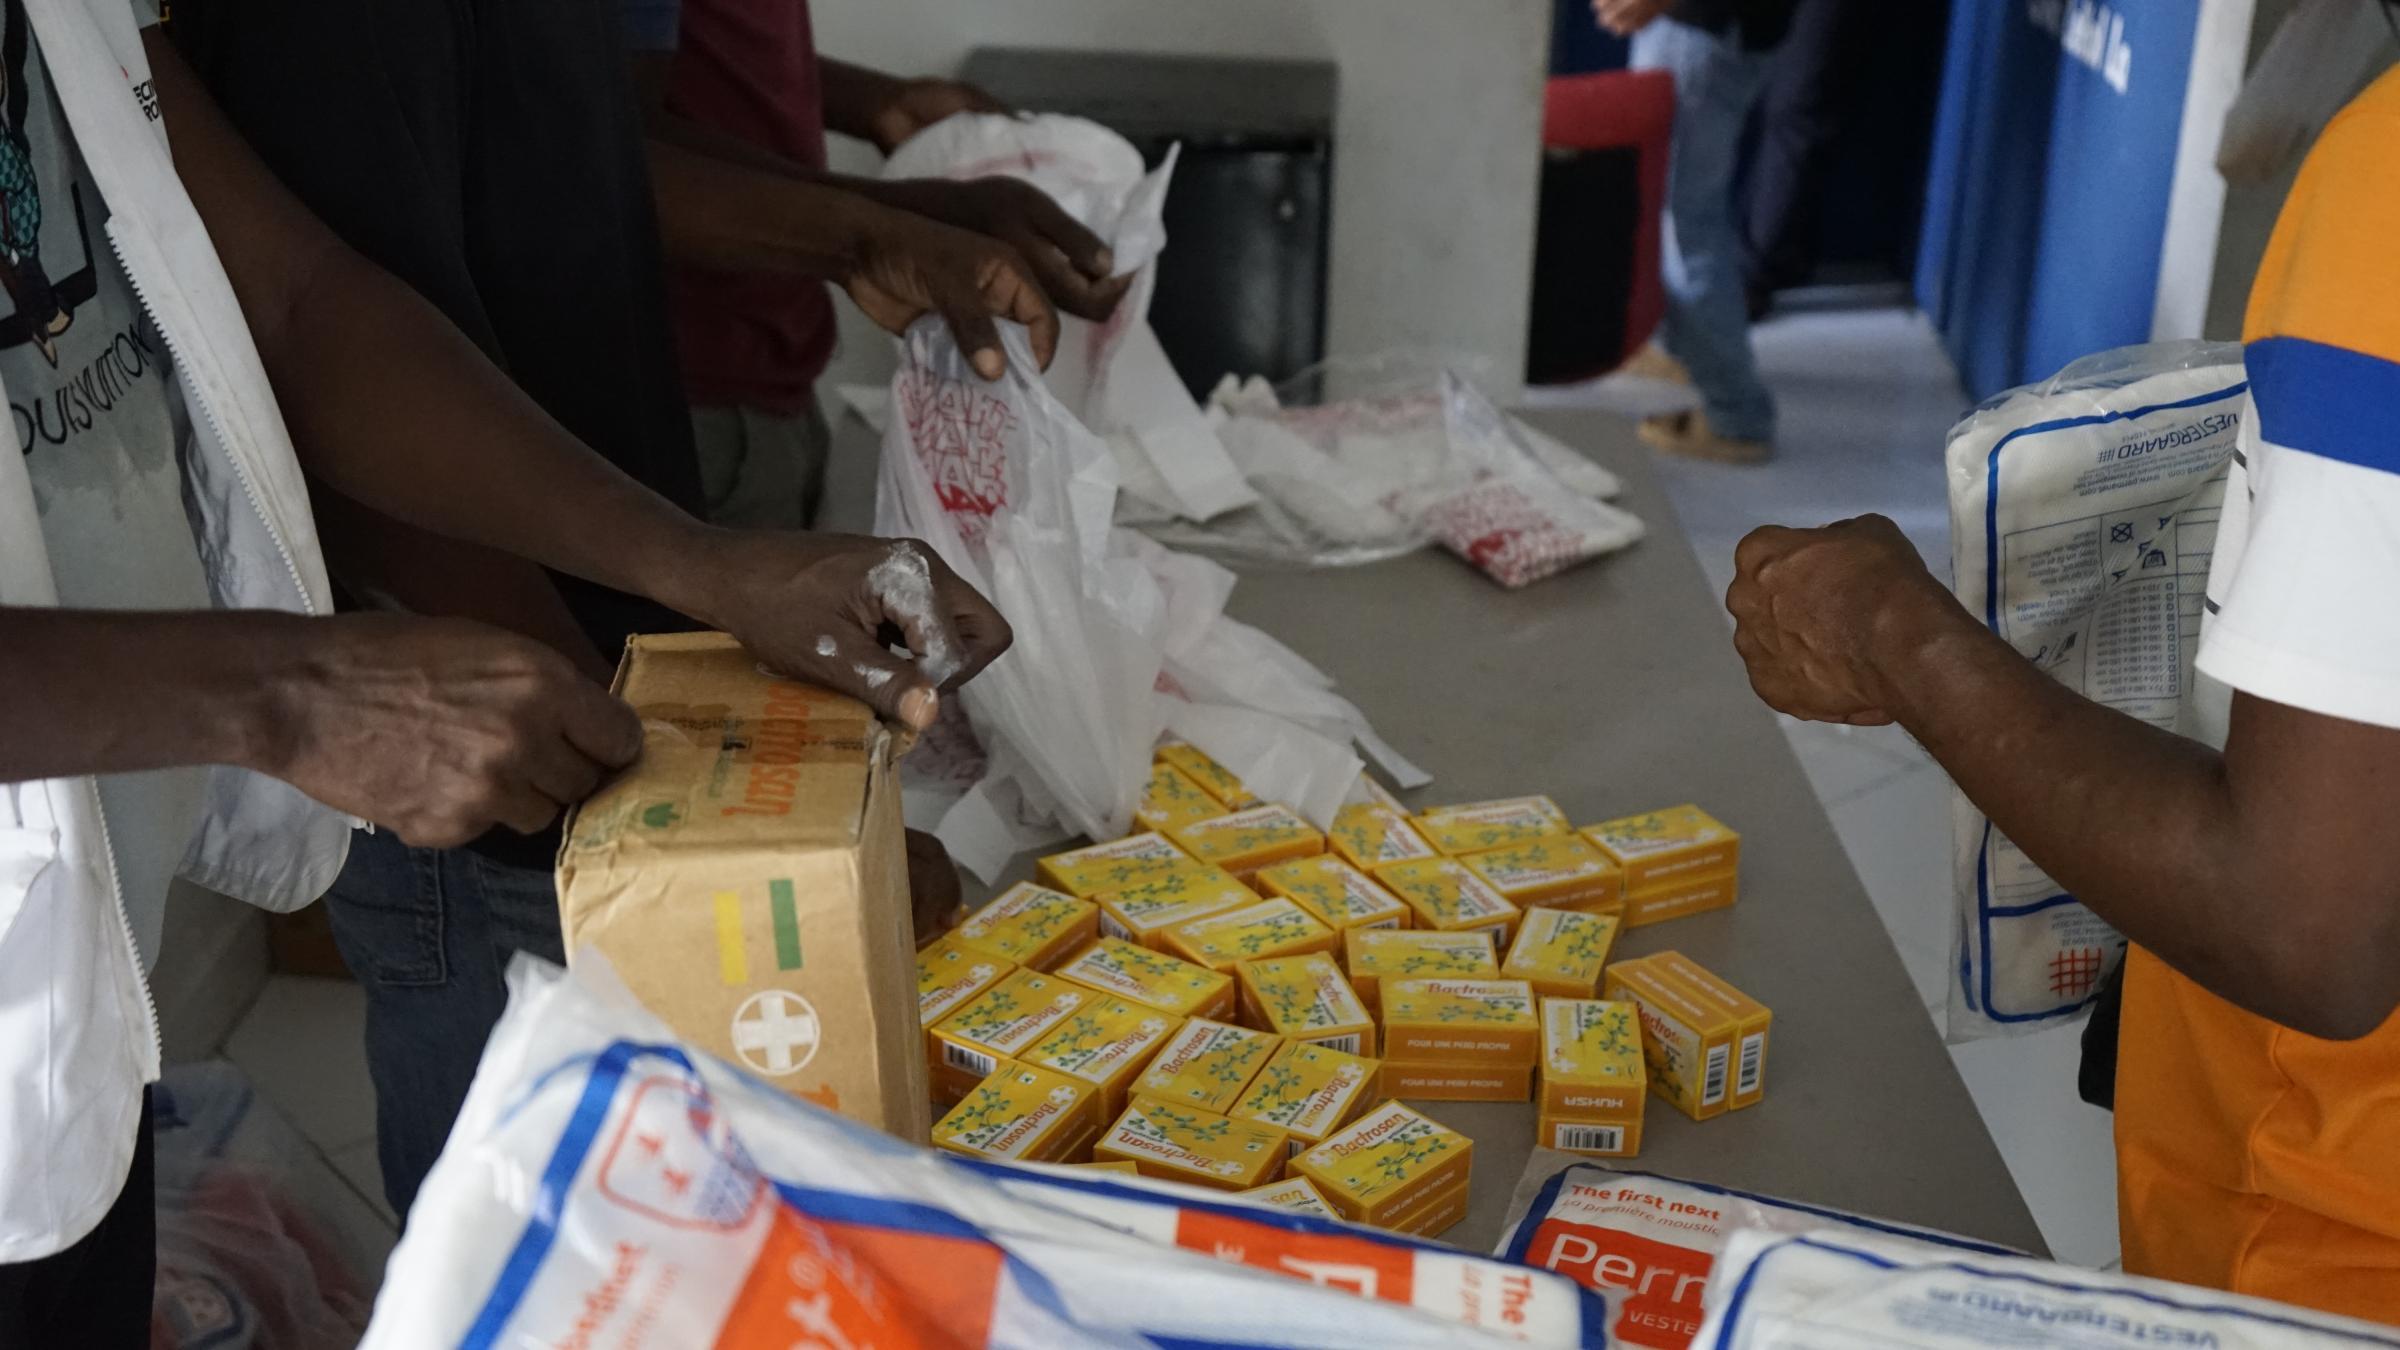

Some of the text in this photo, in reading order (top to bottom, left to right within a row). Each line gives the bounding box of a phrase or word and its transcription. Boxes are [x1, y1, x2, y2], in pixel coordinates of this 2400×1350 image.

[1161, 1026, 1216, 1075] Bactrosan
[990, 1101, 1058, 1154] Bactrosan
[1118, 1132, 1213, 1167] Bactrosan
[1331, 1112, 1408, 1158] Bactrosan
[1572, 1184, 1720, 1221] The first next
[1582, 1201, 1655, 1222] première
[1502, 1274, 1533, 1325] The
